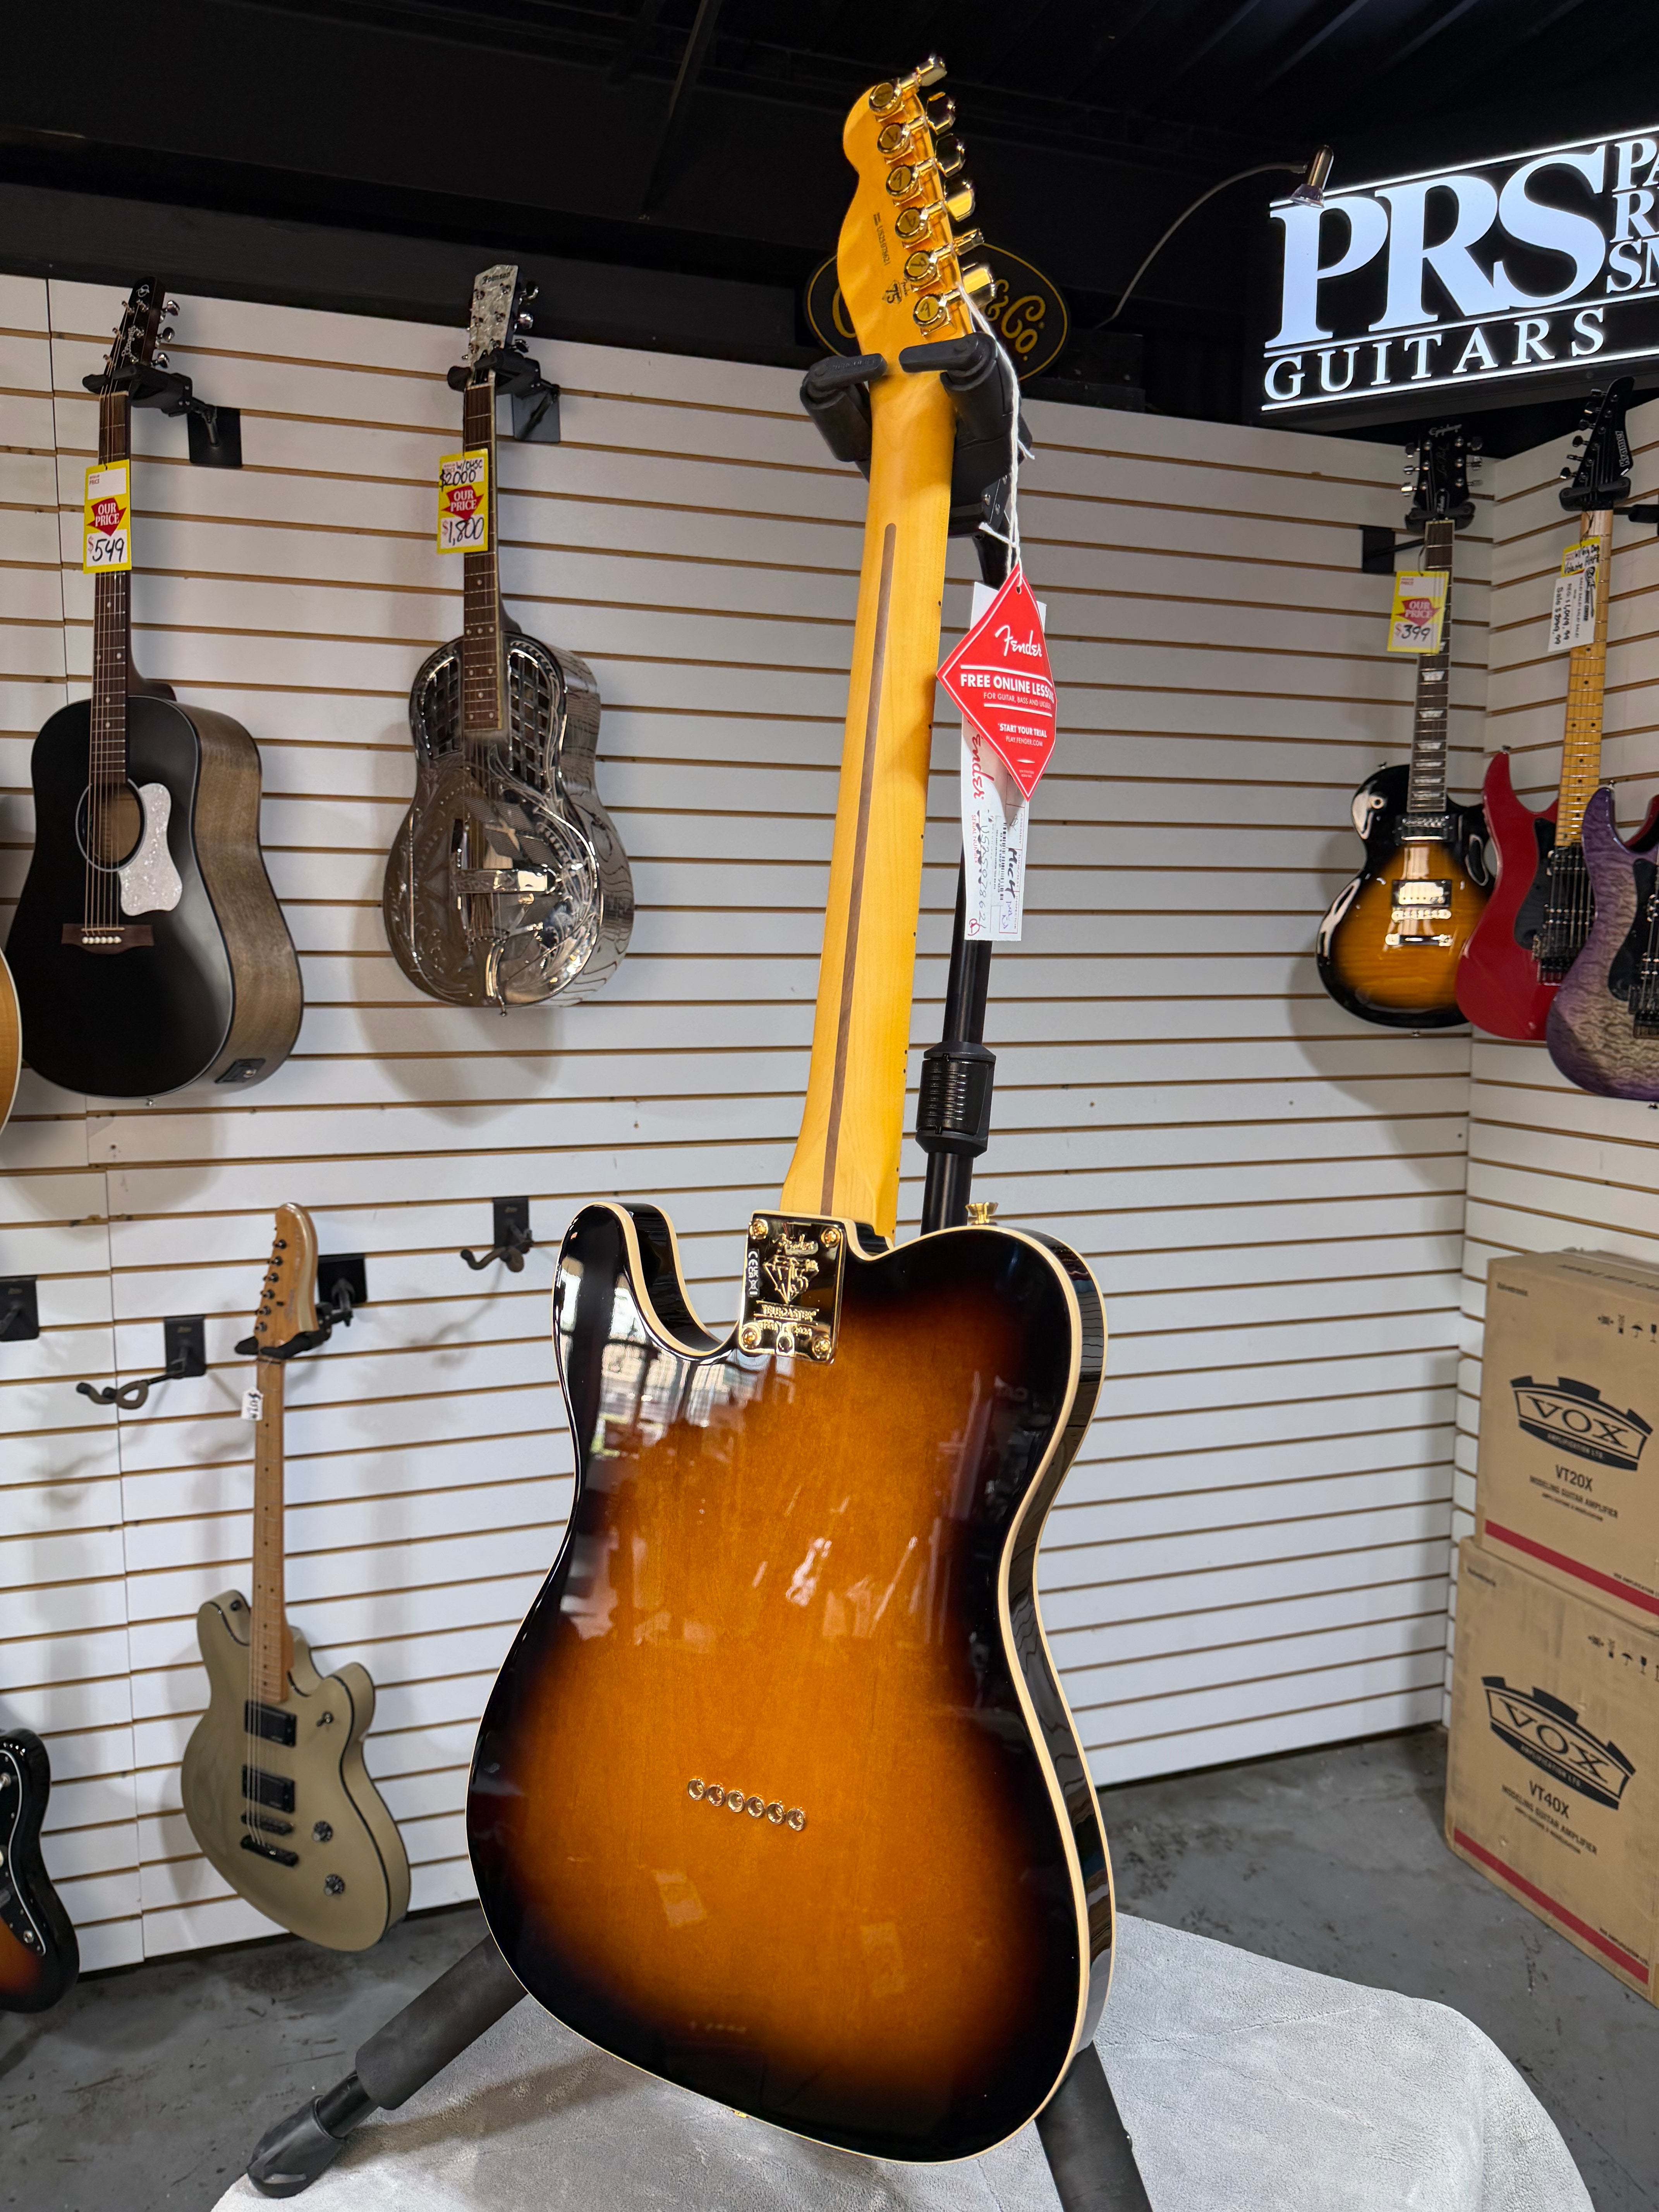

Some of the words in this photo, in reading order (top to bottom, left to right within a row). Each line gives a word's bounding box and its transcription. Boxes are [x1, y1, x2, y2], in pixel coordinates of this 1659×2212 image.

[1265, 145, 1606, 349] PRS
[1264, 308, 1604, 400] GUITARS
[453, 489, 474, 502] OUR
[98, 502, 116, 515] OUR
[450, 499, 477, 512] PRICE
[95, 513, 120, 527] PRICE
[1405, 610, 1433, 618] PRICE
[1409, 601, 1431, 610] OUR
[995, 625, 1042, 657] Fender
[961, 674, 990, 687] FREE
[993, 676, 1030, 694] ONLINE
[1029, 698, 1038, 706] AND
[1018, 725, 1032, 735] YOUR
[1034, 728, 1047, 738] TRIAL
[1006, 736, 1042, 747] PLAY.FENDER.COM
[971, 733, 994, 799] ender
[1527, 1395, 1628, 1449] VOX
[1555, 1464, 1593, 1492] VT20X
[1499, 1697, 1609, 1784] VOX
[1529, 1779, 1570, 1819] VT40X
